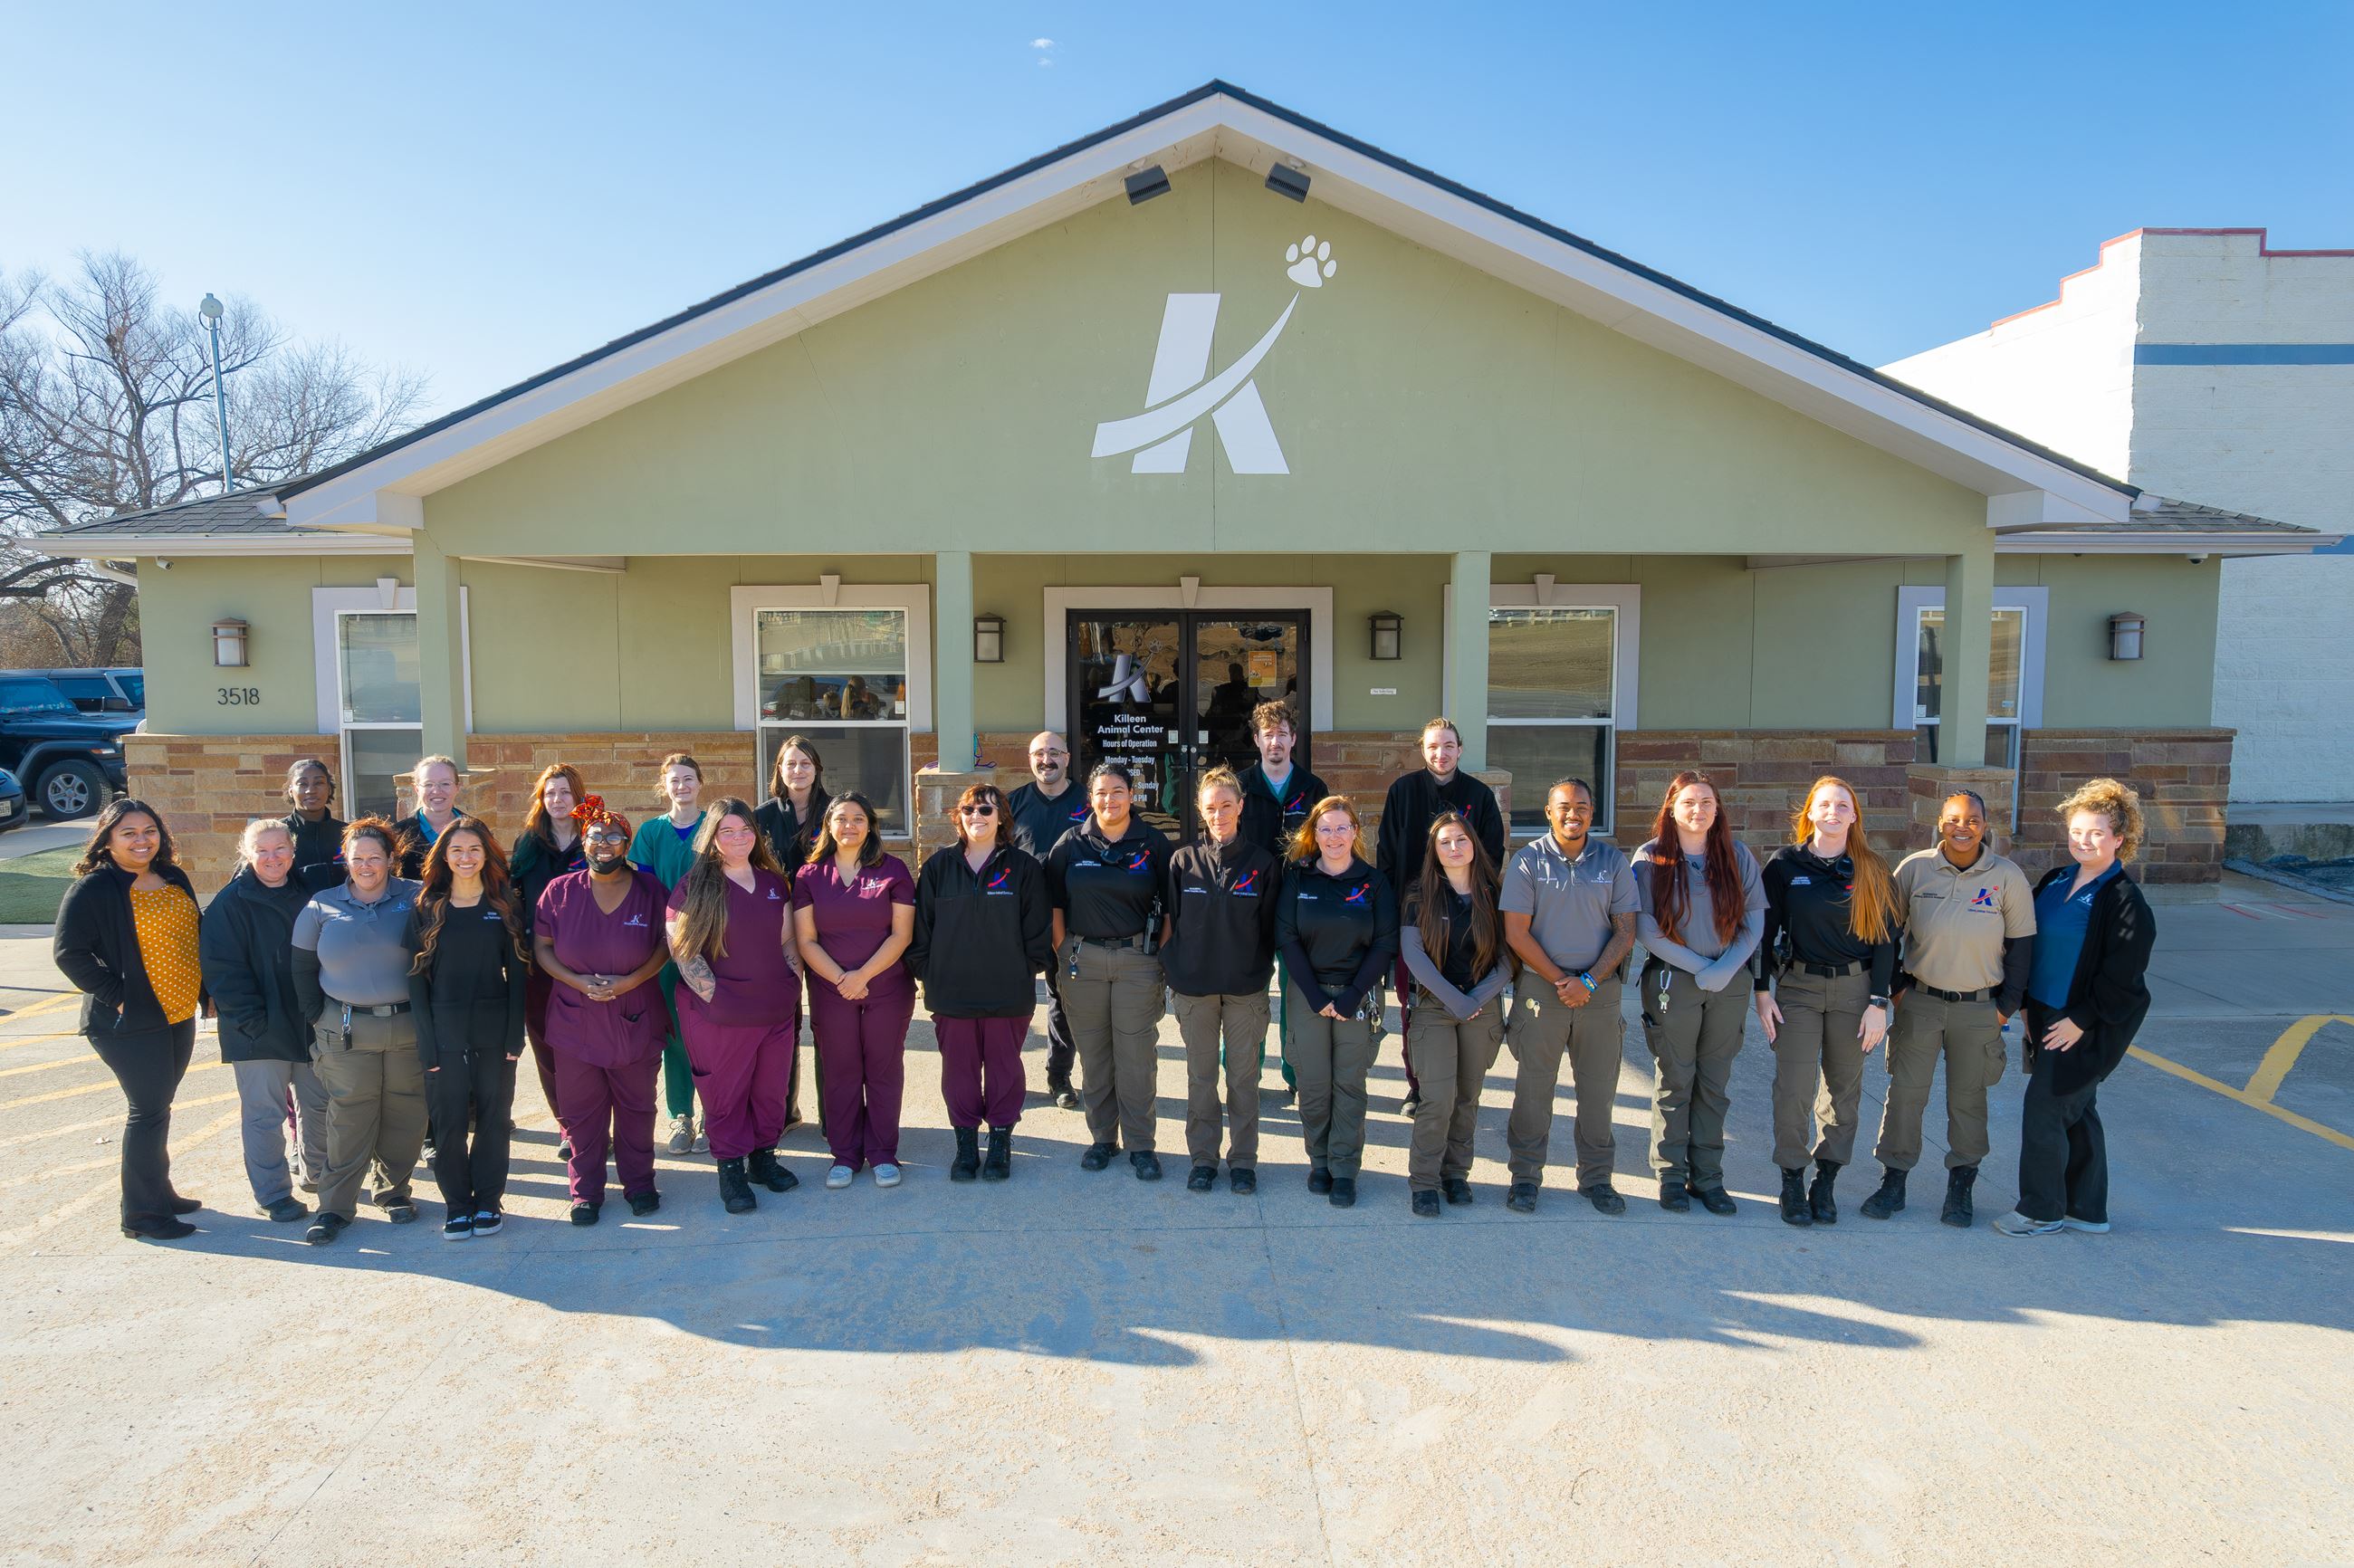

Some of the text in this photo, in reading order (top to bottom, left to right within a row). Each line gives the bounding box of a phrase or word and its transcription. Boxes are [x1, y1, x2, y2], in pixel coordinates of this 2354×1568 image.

[217, 687, 260, 705] 3518
[1114, 713, 1147, 723] Killeen
[1097, 725, 1164, 734] Animal Center
[1103, 739, 1157, 750] Hours of Operation
[1105, 755, 1128, 766] Monday
[1131, 755, 1155, 766] Tuesday
[1137, 781, 1160, 791] Sunday
[1133, 794, 1148, 802] 6 PM
